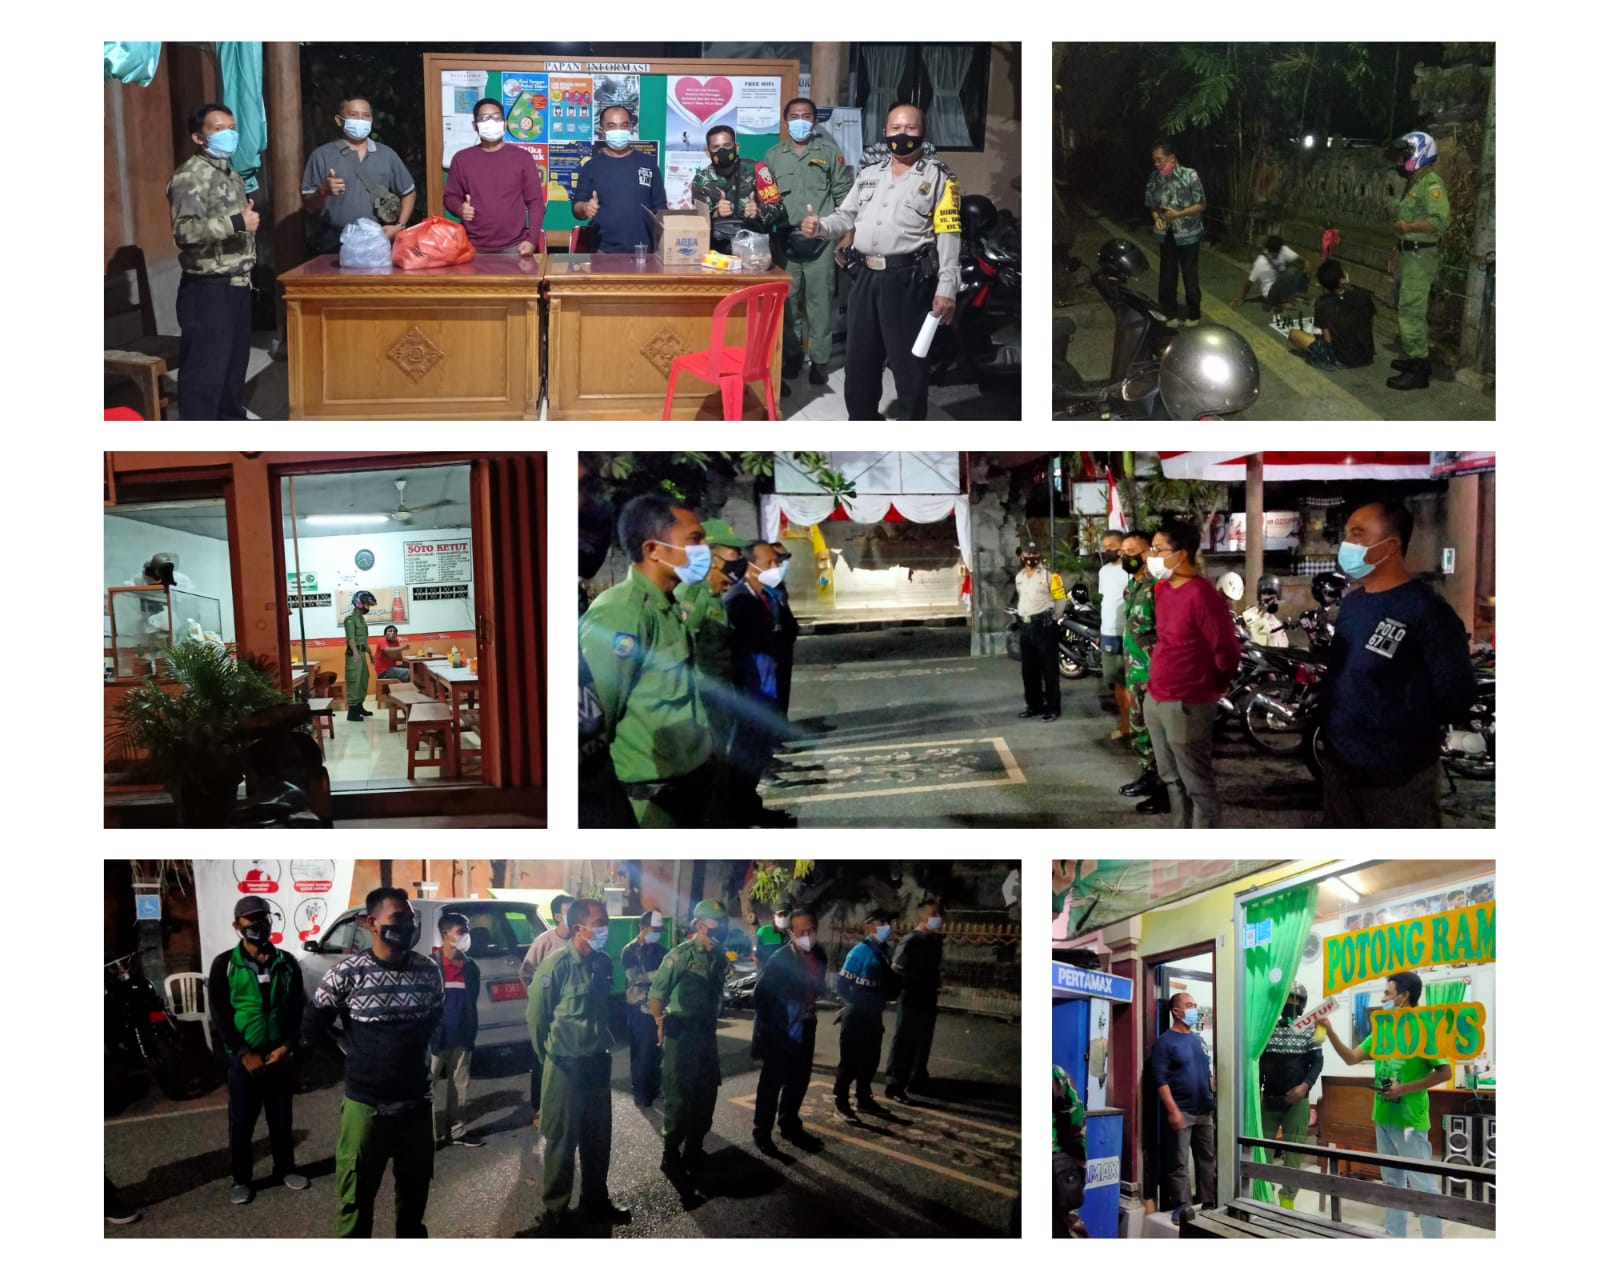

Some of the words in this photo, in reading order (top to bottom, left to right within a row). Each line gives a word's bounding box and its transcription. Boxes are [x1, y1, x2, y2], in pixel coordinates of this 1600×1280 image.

[545, 62, 580, 71] PAPAN
[587, 63, 648, 72] INFORMASI
[675, 238, 698, 246] AQUA
[408, 544, 434, 553] SOTO
[437, 543, 468, 552] KETUT
[1368, 633, 1384, 647] 67
[1375, 621, 1407, 642] POLO
[1327, 920, 1425, 989] POTONG
[1431, 906, 1496, 962] RAM
[1058, 967, 1113, 994] PERTAMAX
[1294, 1002, 1335, 1030] TUTUP
[1374, 1006, 1479, 1056] BOY'S
